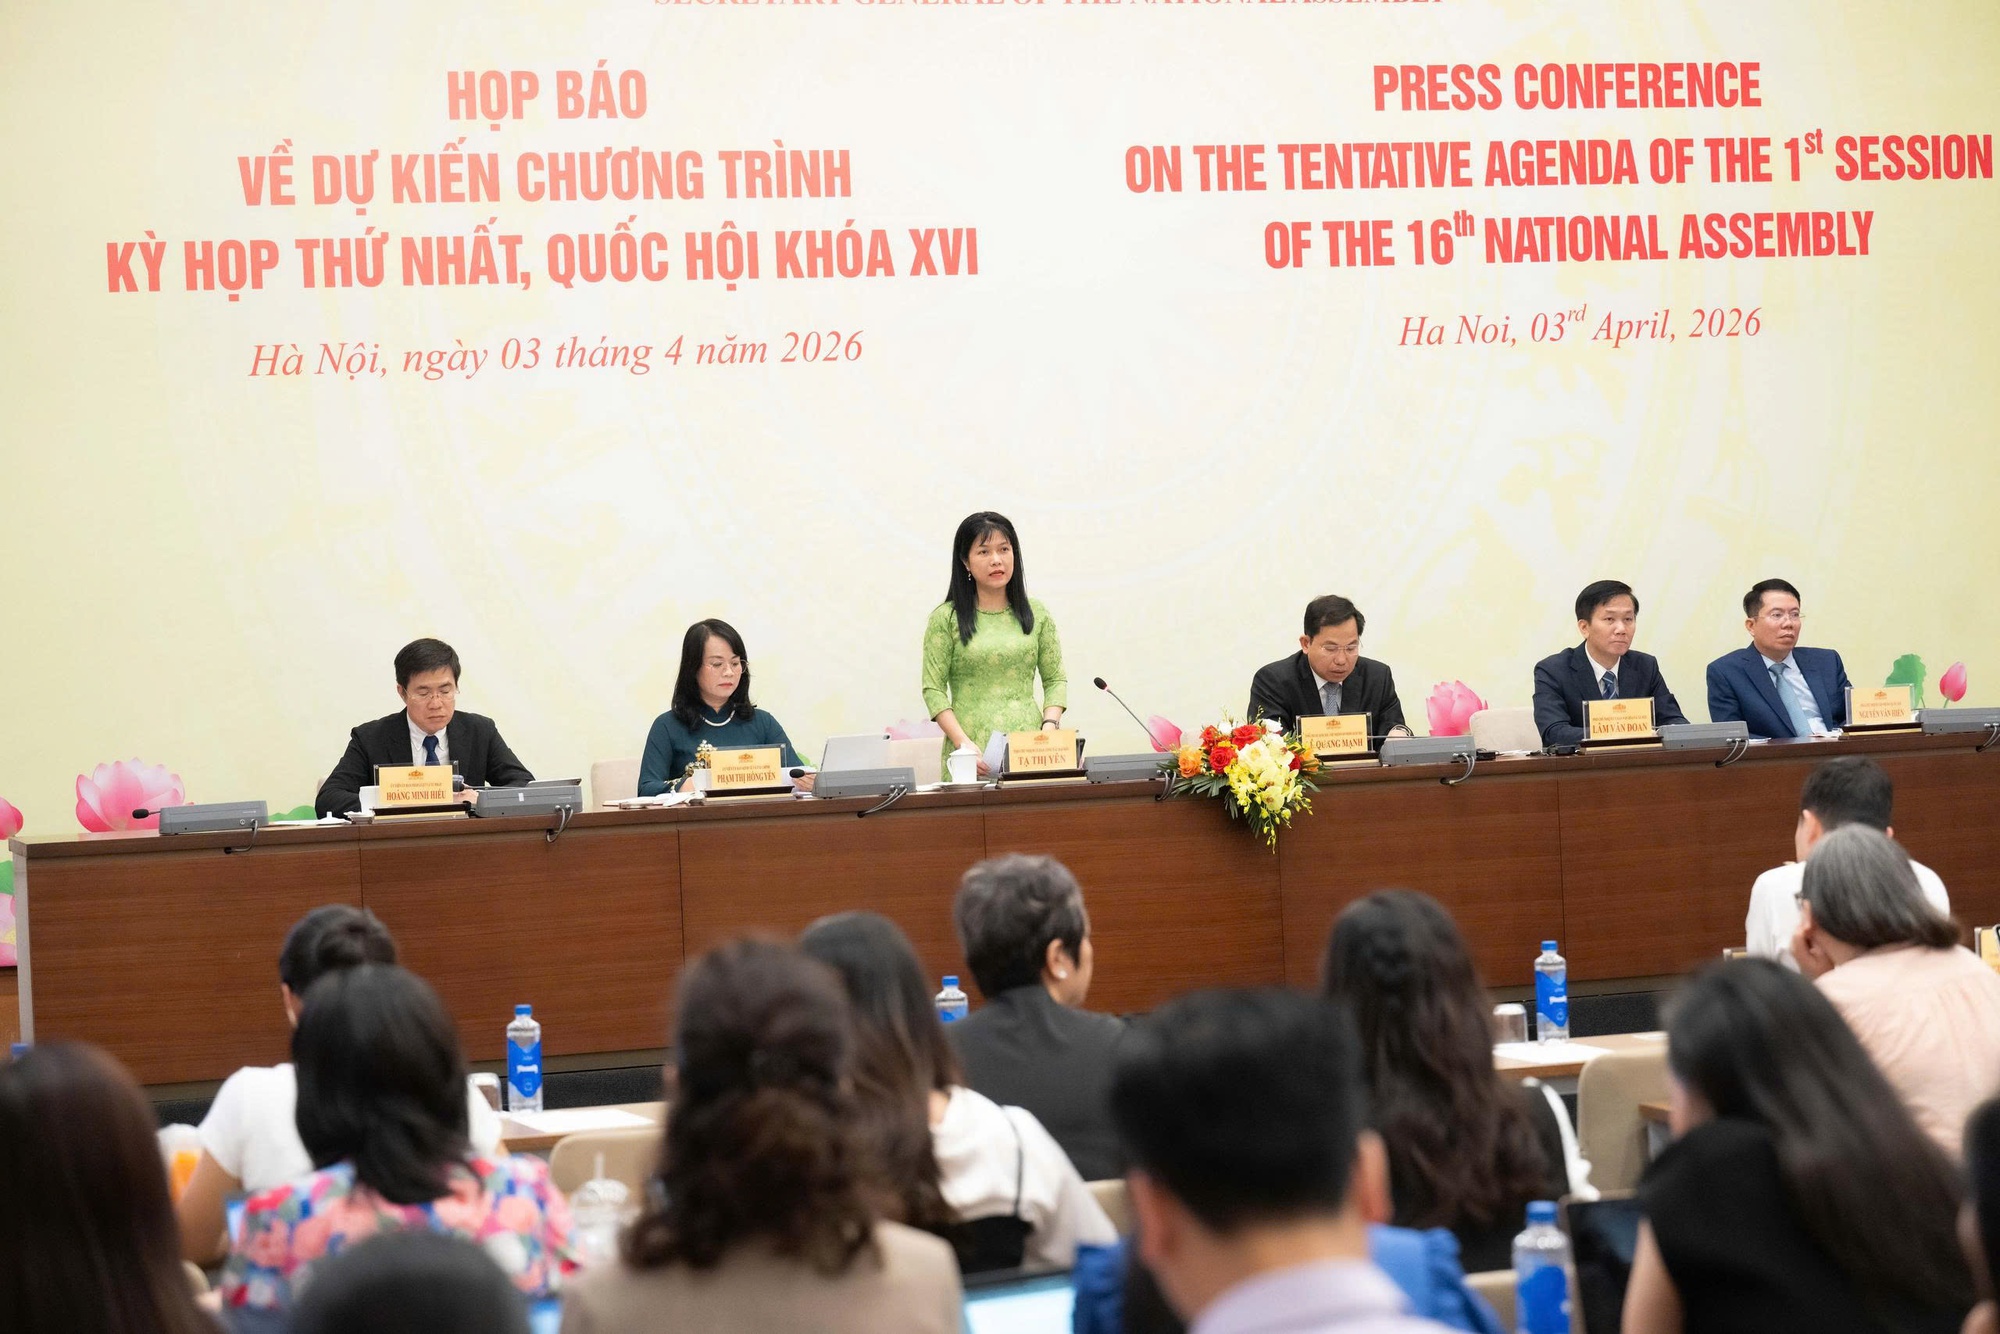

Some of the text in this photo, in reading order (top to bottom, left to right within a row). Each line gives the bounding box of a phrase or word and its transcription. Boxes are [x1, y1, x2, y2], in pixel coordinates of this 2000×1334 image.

[447, 59, 647, 132] HỌP BÁO
[1373, 61, 1763, 112] PRESS CONFERENCE
[237, 136, 852, 216] VỀ DỰ KIẾN CHƯƠNG TRÌNH
[1125, 145, 1183, 194] ON
[1192, 144, 1267, 192] THE
[1277, 141, 1474, 191] TENTATIVE
[1484, 138, 1640, 187] AGENDA
[1648, 137, 1695, 185] OF
[1703, 136, 1773, 184] THE
[1834, 133, 1994, 183] SESSION
[106, 214, 979, 303] KỲ HỌP THỨ NHẤT, QUỐC HỘI KHÓA XVI
[1264, 221, 1312, 270] OF
[1322, 219, 1396, 268] THE
[1484, 214, 1669, 264] NATIONAL
[1678, 210, 1875, 260] ASSEMBLY
[1400, 316, 1445, 346] Ha
[1454, 314, 1516, 347] Noi,
[1592, 309, 1675, 349] April,
[1687, 306, 1761, 338] 2026
[250, 330, 862, 382] Hà Nội, ngày 03 tháng 4 năm 2026
[1316, 740, 1341, 750] QUANG
[1342, 738, 1363, 749] MẠNH
[1593, 723, 1609, 734] LÂM
[1610, 721, 1626, 732] VĂN
[717, 774, 735, 784] PHẠM
[735, 773, 746, 784] THỊ
[1018, 756, 1030, 767] TẠ
[1031, 755, 1047, 766] THỊ
[412, 791, 429, 800] MINH
